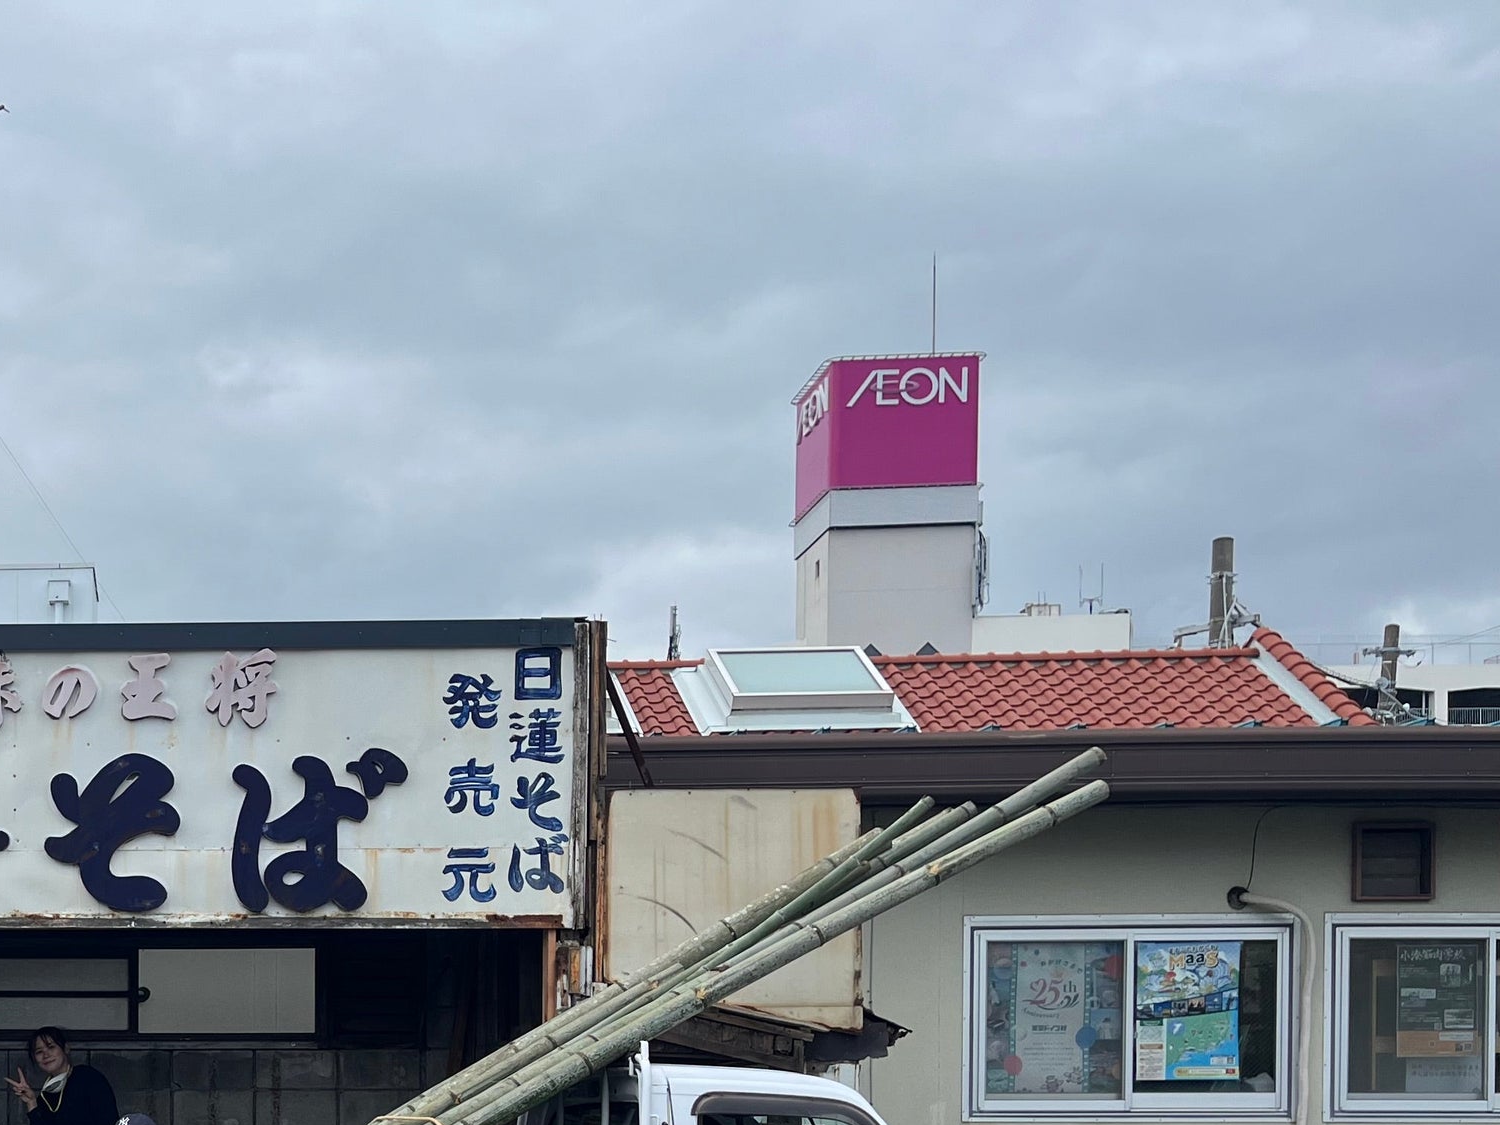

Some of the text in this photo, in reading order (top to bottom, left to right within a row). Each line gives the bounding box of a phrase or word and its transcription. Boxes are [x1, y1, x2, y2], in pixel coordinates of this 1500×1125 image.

[442, 673, 501, 903] 発売元
[510, 648, 568, 894] 日蓮そば
[1168, 949, 1220, 971] MaaS
